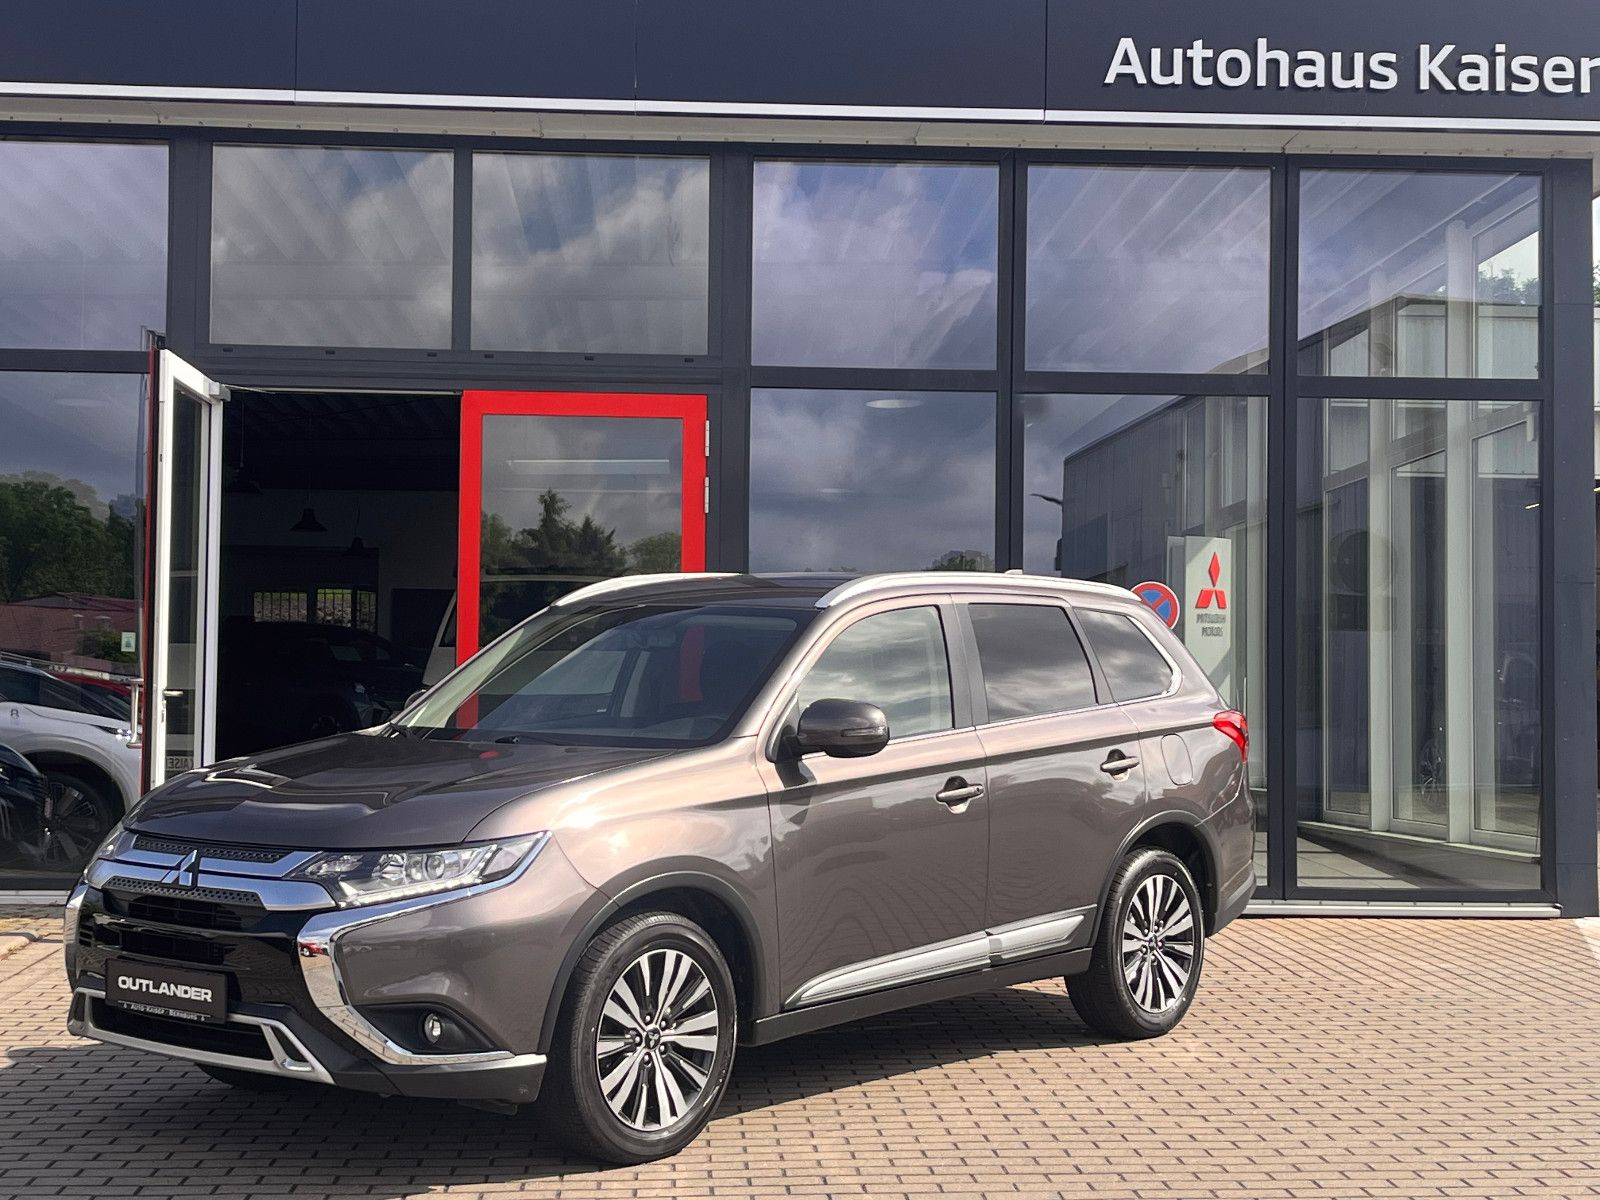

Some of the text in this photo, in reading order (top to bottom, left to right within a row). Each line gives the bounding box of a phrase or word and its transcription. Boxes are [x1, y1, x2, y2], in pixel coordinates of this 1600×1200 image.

[1104, 37, 1600, 94] Autohaus Kaiser
[118, 975, 212, 1002] OUTLANDER
